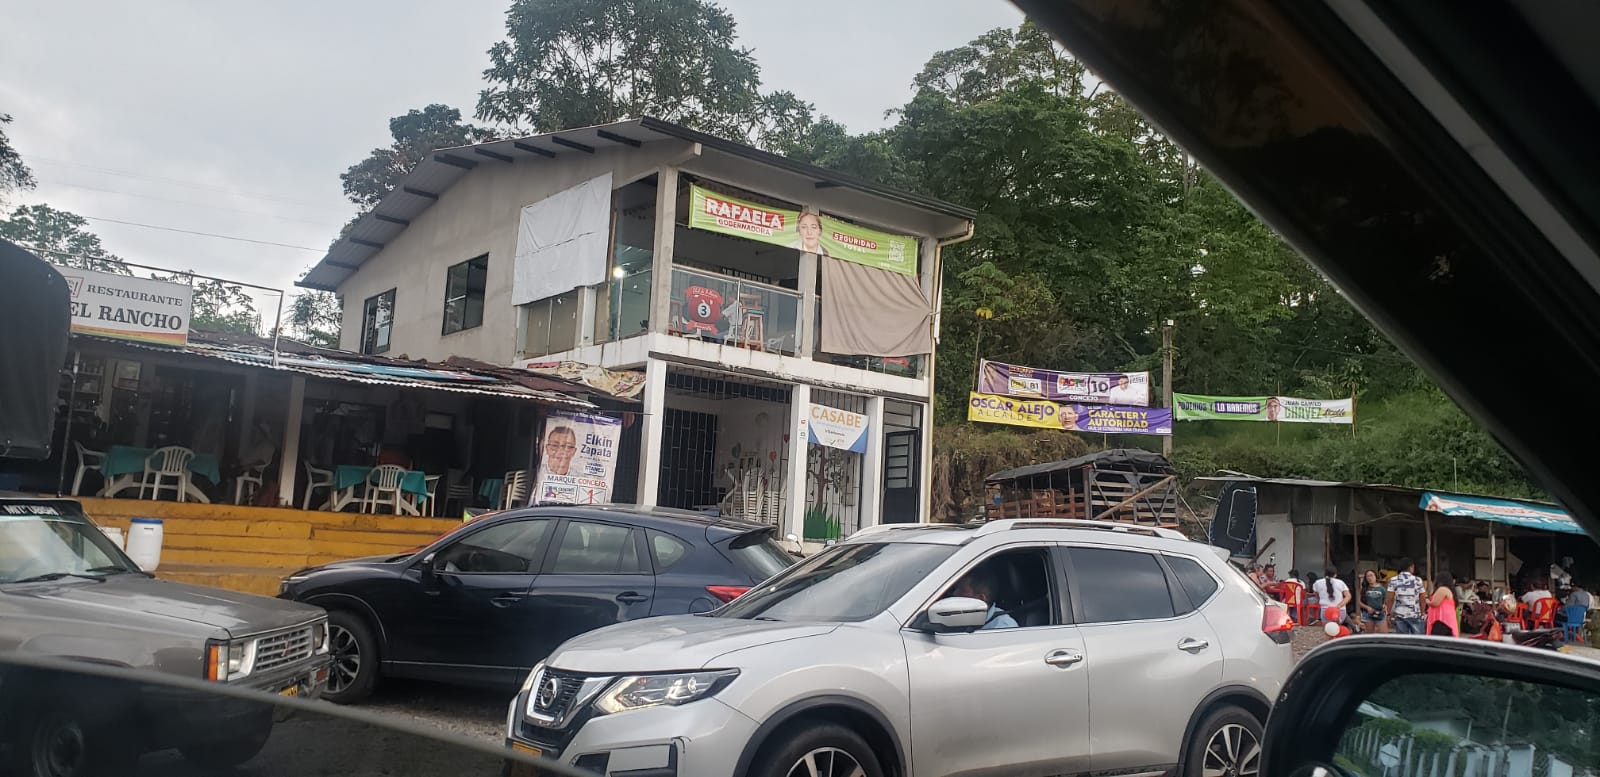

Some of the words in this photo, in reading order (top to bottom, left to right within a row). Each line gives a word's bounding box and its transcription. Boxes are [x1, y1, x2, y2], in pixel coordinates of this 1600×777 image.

[706, 198, 782, 229] RAFAELA
[718, 219, 770, 236] GOBERNADORA
[833, 233, 876, 249] SEGURIDAD
[87, 284, 183, 306] RESTAURANTE
[70, 301, 91, 318] EL
[98, 305, 182, 330] RANCHO
[700, 305, 707, 316] 3
[1090, 380, 1109, 393] 10
[971, 397, 1013, 411] OSCAR
[1018, 404, 1054, 420] ALEJO
[978, 409, 1032, 422] ALCALDE
[1141, 411, 1148, 420] Y
[812, 406, 862, 428] CASABE
[1088, 418, 1149, 428] AUTORIDAD
[586, 434, 613, 448] Elkin
[580, 444, 612, 457] Zapata
[547, 475, 576, 484] MARQUE
[588, 489, 594, 504] 1
